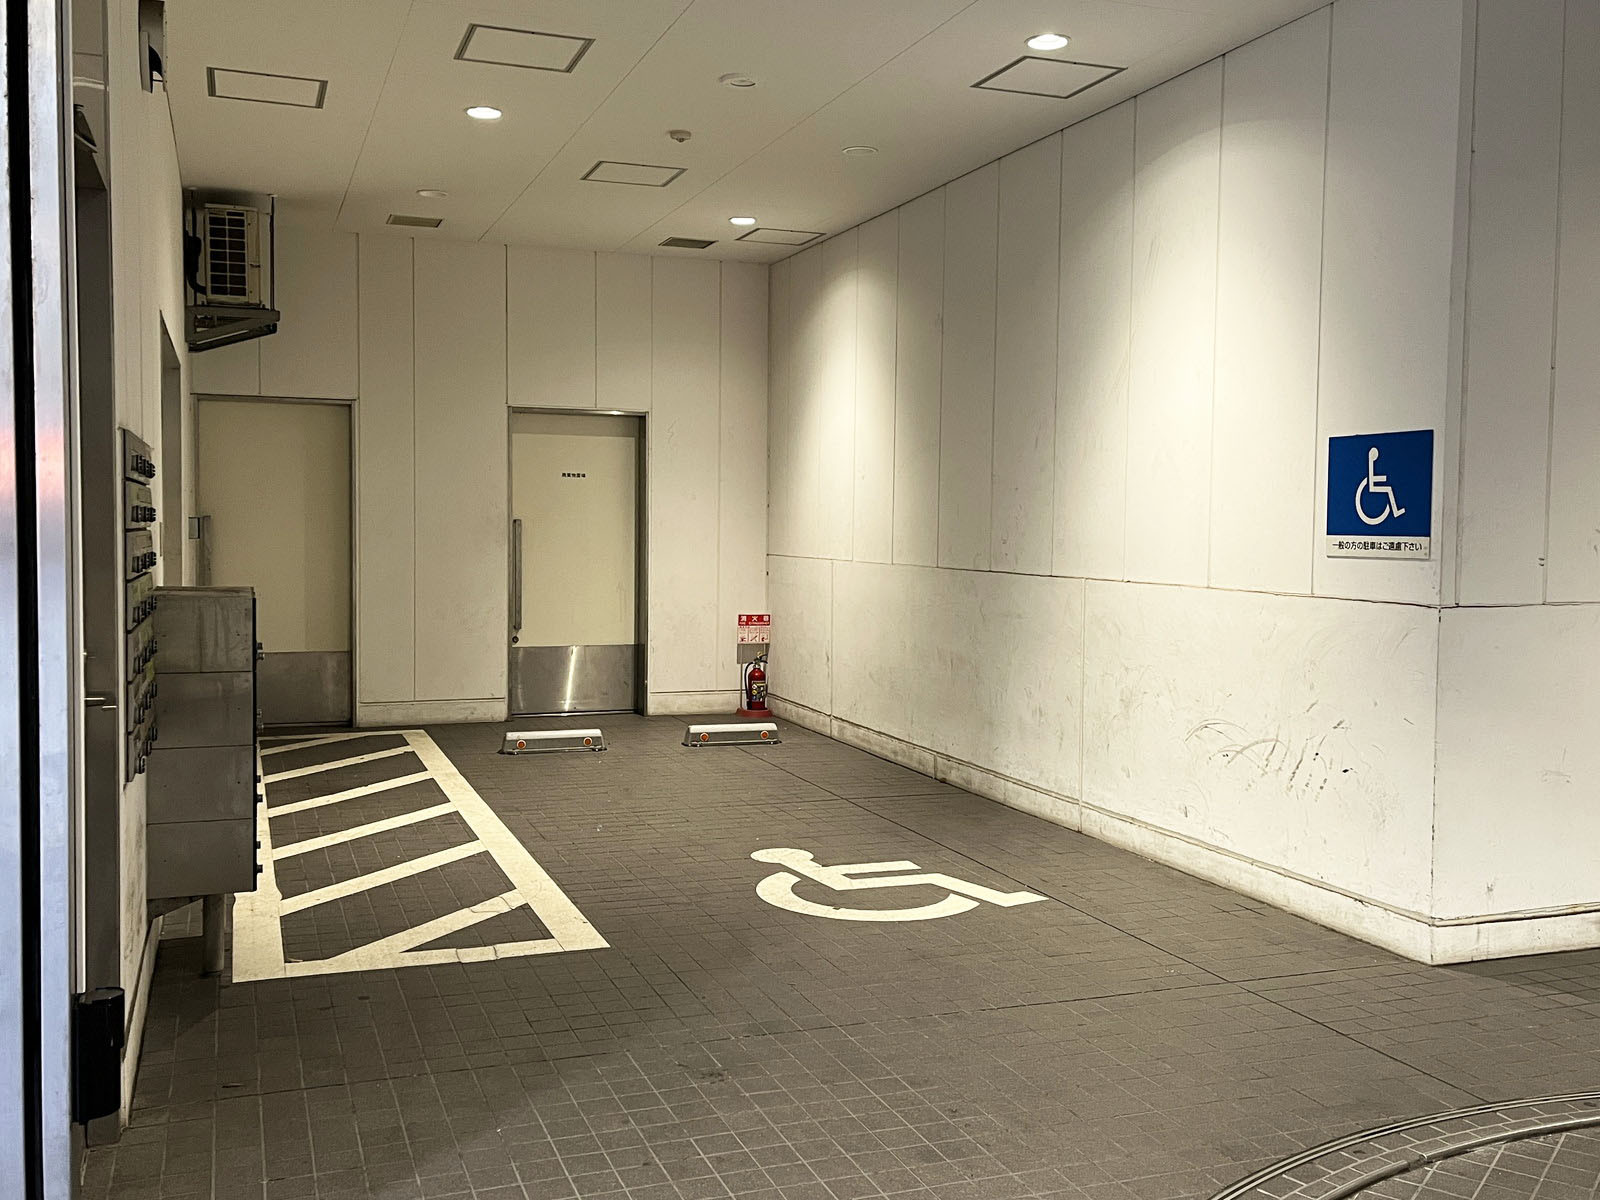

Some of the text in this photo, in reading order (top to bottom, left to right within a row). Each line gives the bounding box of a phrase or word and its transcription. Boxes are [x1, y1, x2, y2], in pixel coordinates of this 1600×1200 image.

[1332, 541, 1423, 551] 一般の方の駐車はご遠慮下さい
